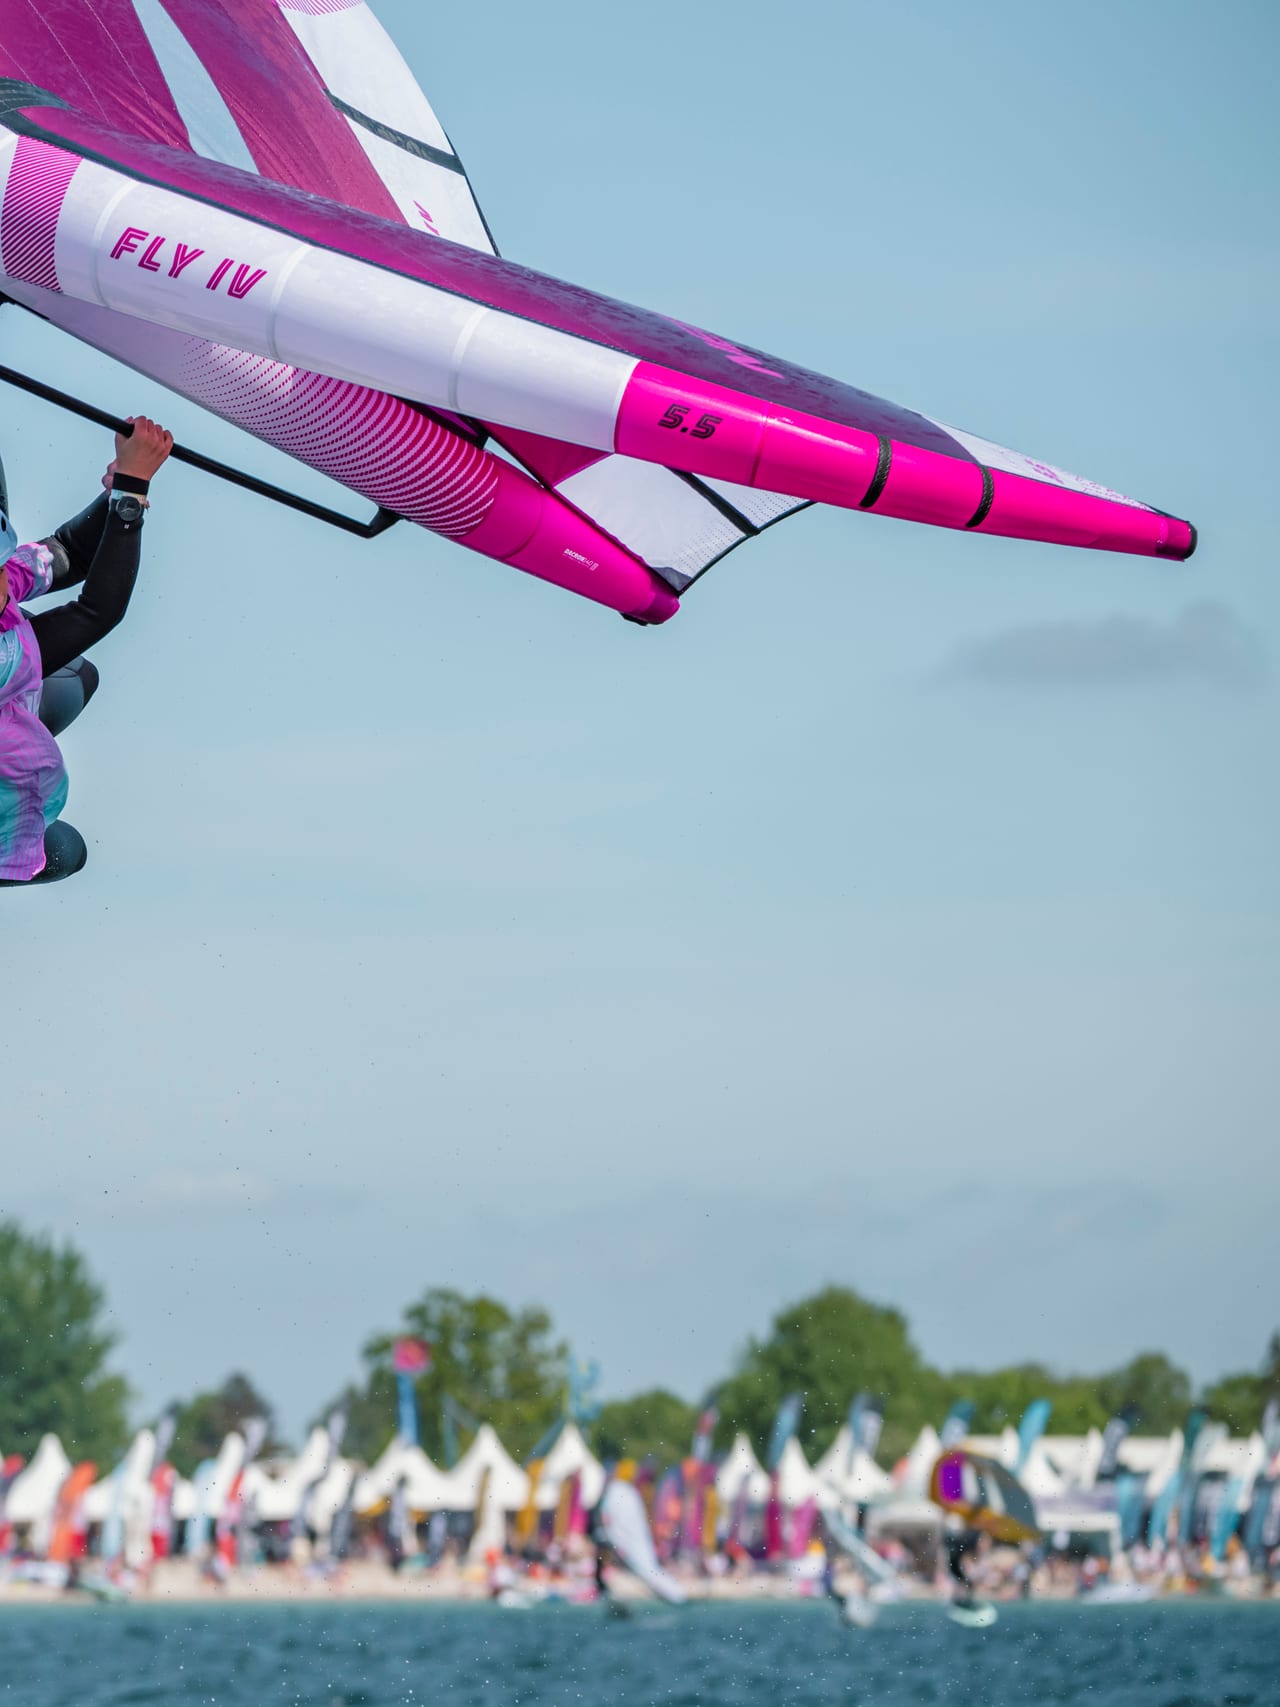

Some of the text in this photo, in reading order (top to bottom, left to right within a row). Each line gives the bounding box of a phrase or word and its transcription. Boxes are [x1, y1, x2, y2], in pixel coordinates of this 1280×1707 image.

[110, 227, 268, 299] FLY IV
[658, 403, 723, 440] 5.5
